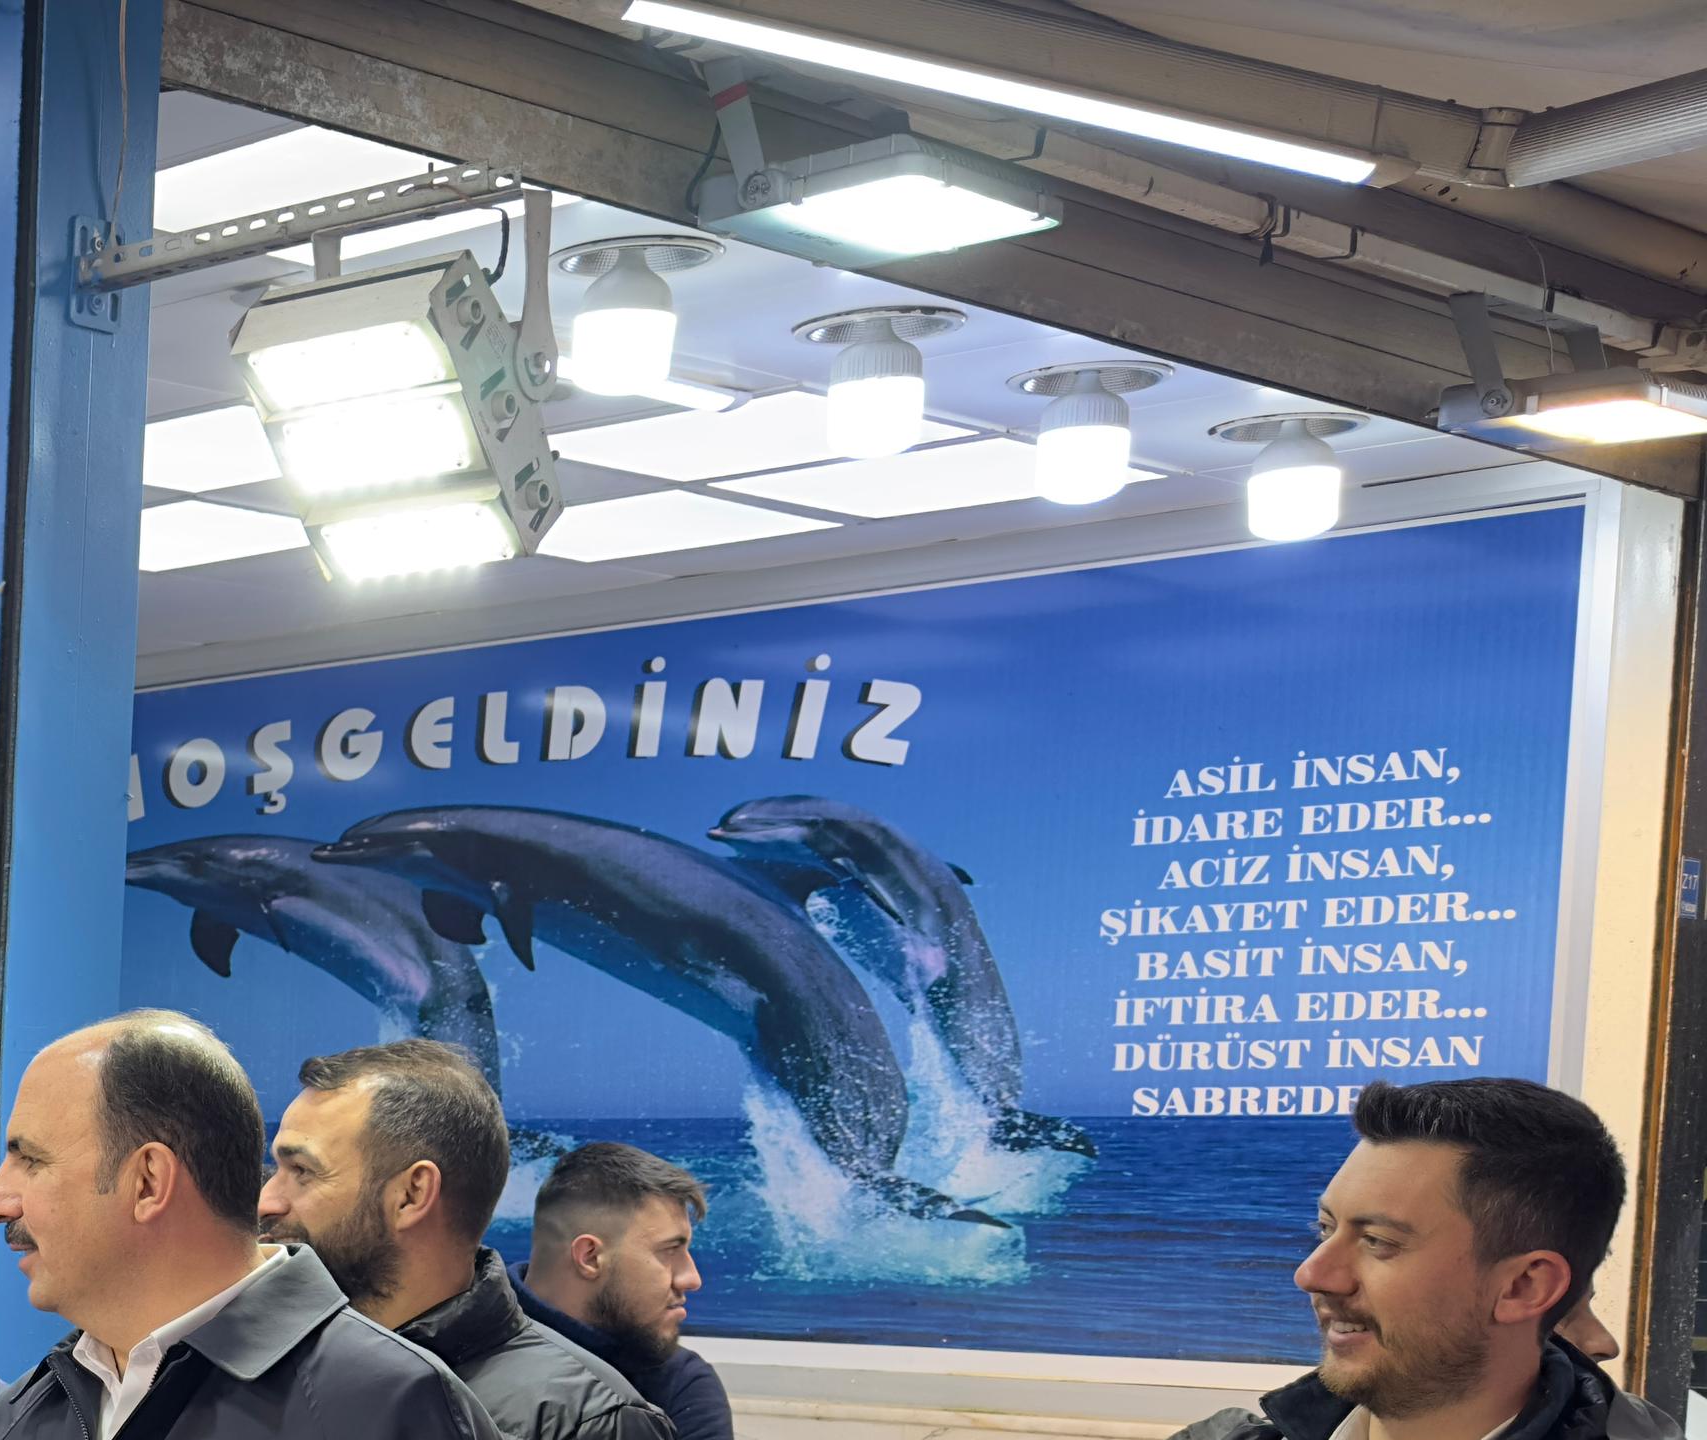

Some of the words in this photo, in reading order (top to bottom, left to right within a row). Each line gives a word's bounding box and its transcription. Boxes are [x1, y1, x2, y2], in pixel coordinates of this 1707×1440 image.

[1164, 755, 1276, 799] ASİL
[1291, 747, 1461, 789] İNSAN,
[1131, 808, 1283, 846] İDARE
[1299, 796, 1492, 836] EDER...
[1157, 848, 1270, 890] ACİZ
[1285, 844, 1455, 883] İNSAN,
[1099, 899, 1307, 945] ŞİKAYET
[1322, 891, 1517, 928] EDER...
[1135, 940, 1283, 981] BASİT
[1297, 937, 1468, 976] İNSAN,
[1113, 987, 1282, 1027] İFTİRA
[1294, 988, 1488, 1022] EDER...
[1112, 1032, 1310, 1072] DÜRÜST
[1325, 1029, 1484, 1069] İNSAN
[1132, 1086, 1363, 1117] SABREDE
